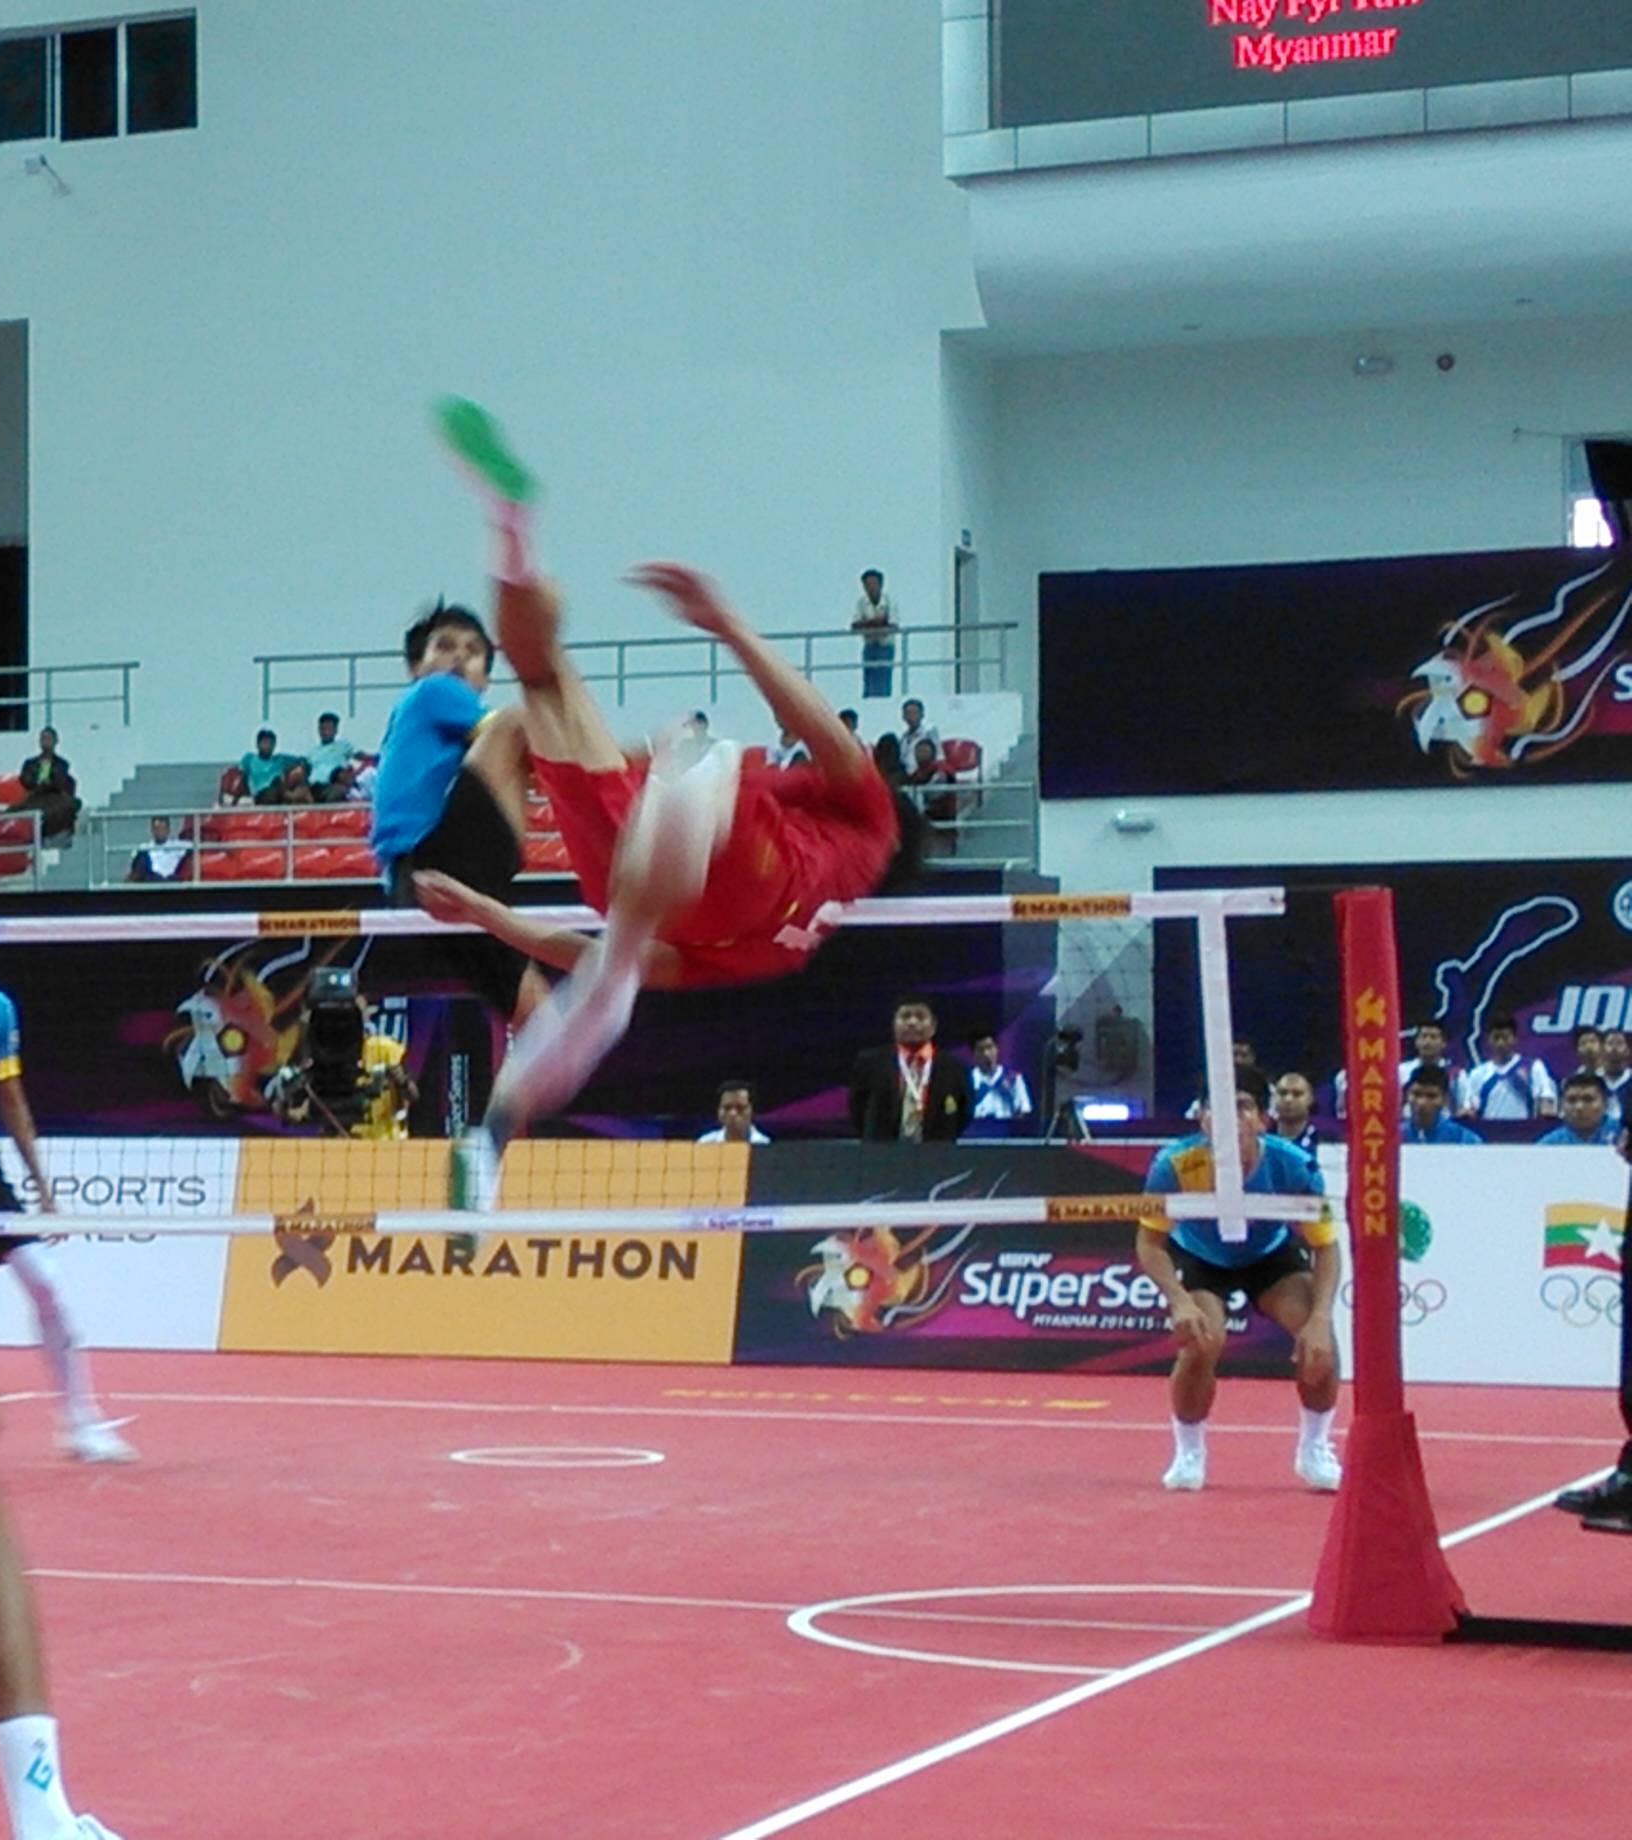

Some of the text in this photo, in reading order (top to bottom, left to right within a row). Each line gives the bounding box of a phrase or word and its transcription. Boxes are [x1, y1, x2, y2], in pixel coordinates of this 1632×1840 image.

[1236, 28, 1399, 72] Myanmar
[1357, 1037, 1387, 1236] MARATHON
[18, 1175, 207, 1209] SPORTS
[347, 1238, 699, 1281] MARATHON
[958, 1260, 1248, 1319] SuperSe
